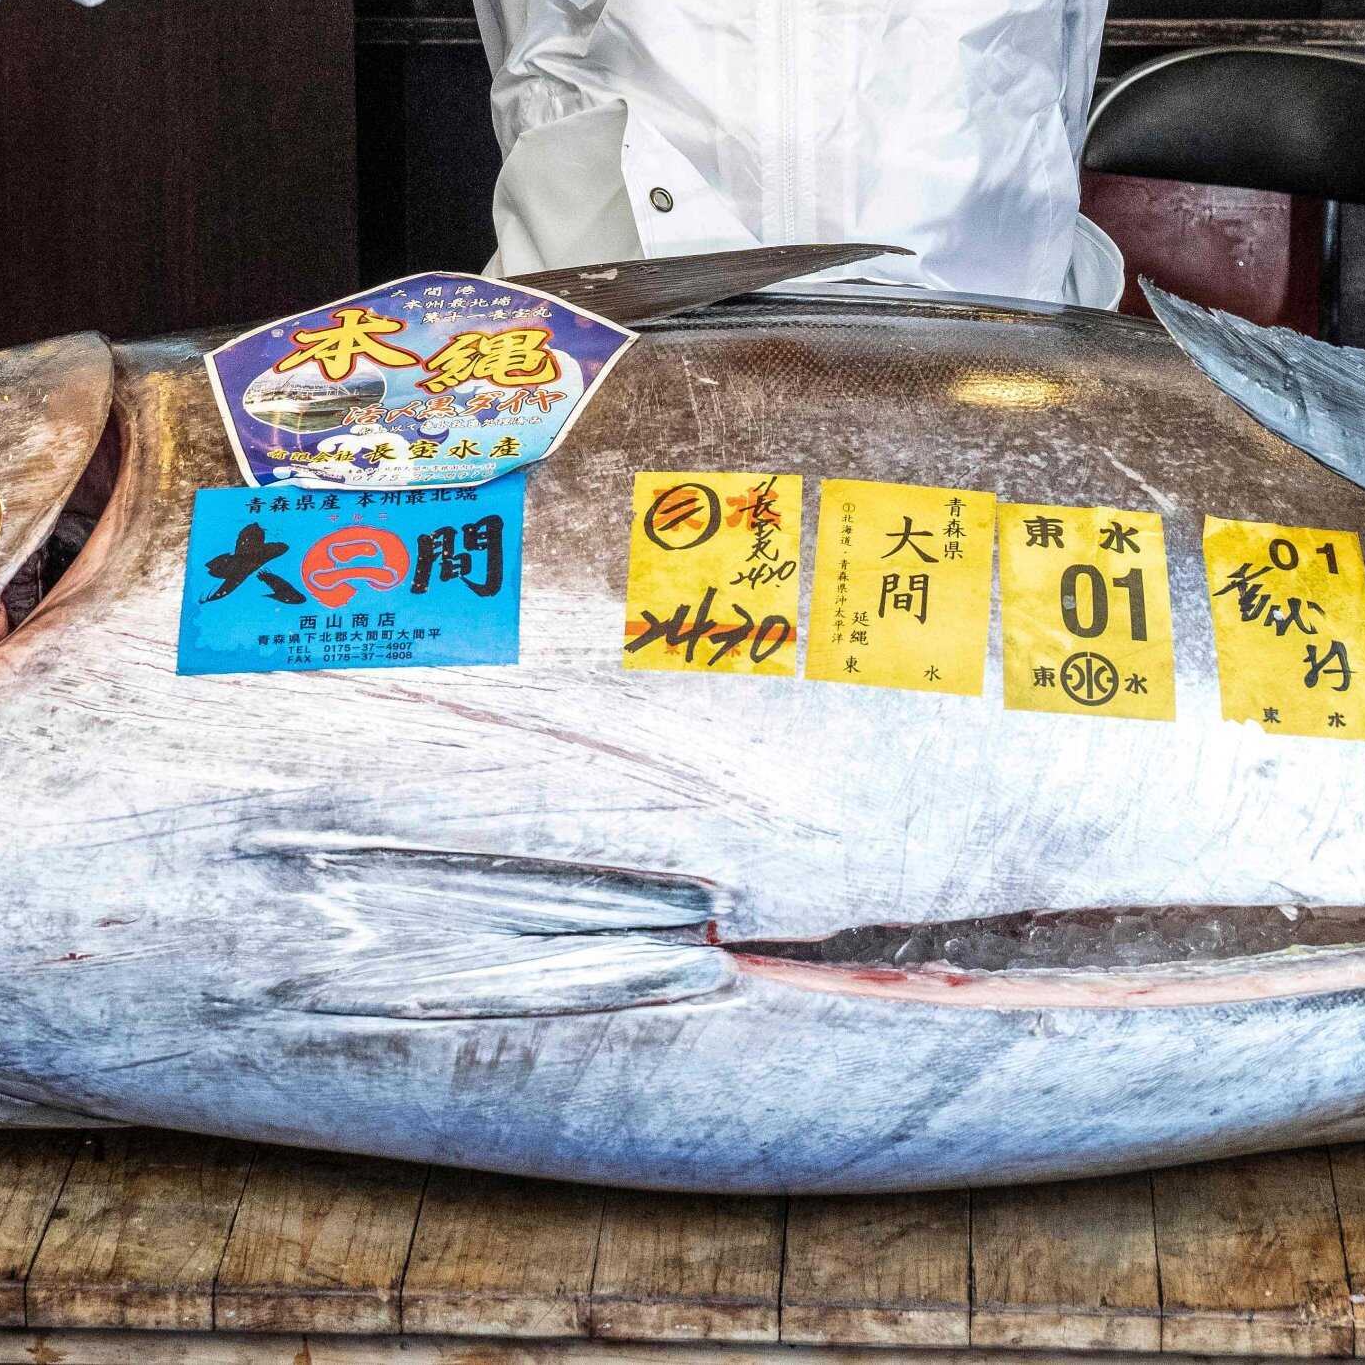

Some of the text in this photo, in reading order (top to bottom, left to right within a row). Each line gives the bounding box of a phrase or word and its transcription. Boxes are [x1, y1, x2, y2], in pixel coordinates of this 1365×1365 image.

[275, 308, 561, 394] 本縄
[362, 436, 523, 462] 長宝水産
[245, 487, 479, 514] 青森県産 本州最北端
[943, 497, 968, 560] 青森県
[1023, 515, 1141, 554] 東水
[878, 516, 939, 625] 大間
[1268, 538, 1339, 575] 01
[1060, 563, 1148, 642] 01
[299, 612, 395, 630] 西山商店
[258, 628, 441, 646] 青森県下北郡大間町大間平
[288, 646, 311, 654] TEL
[287, 655, 311, 664] FAX
[1032, 665, 1148, 695] 東 水
